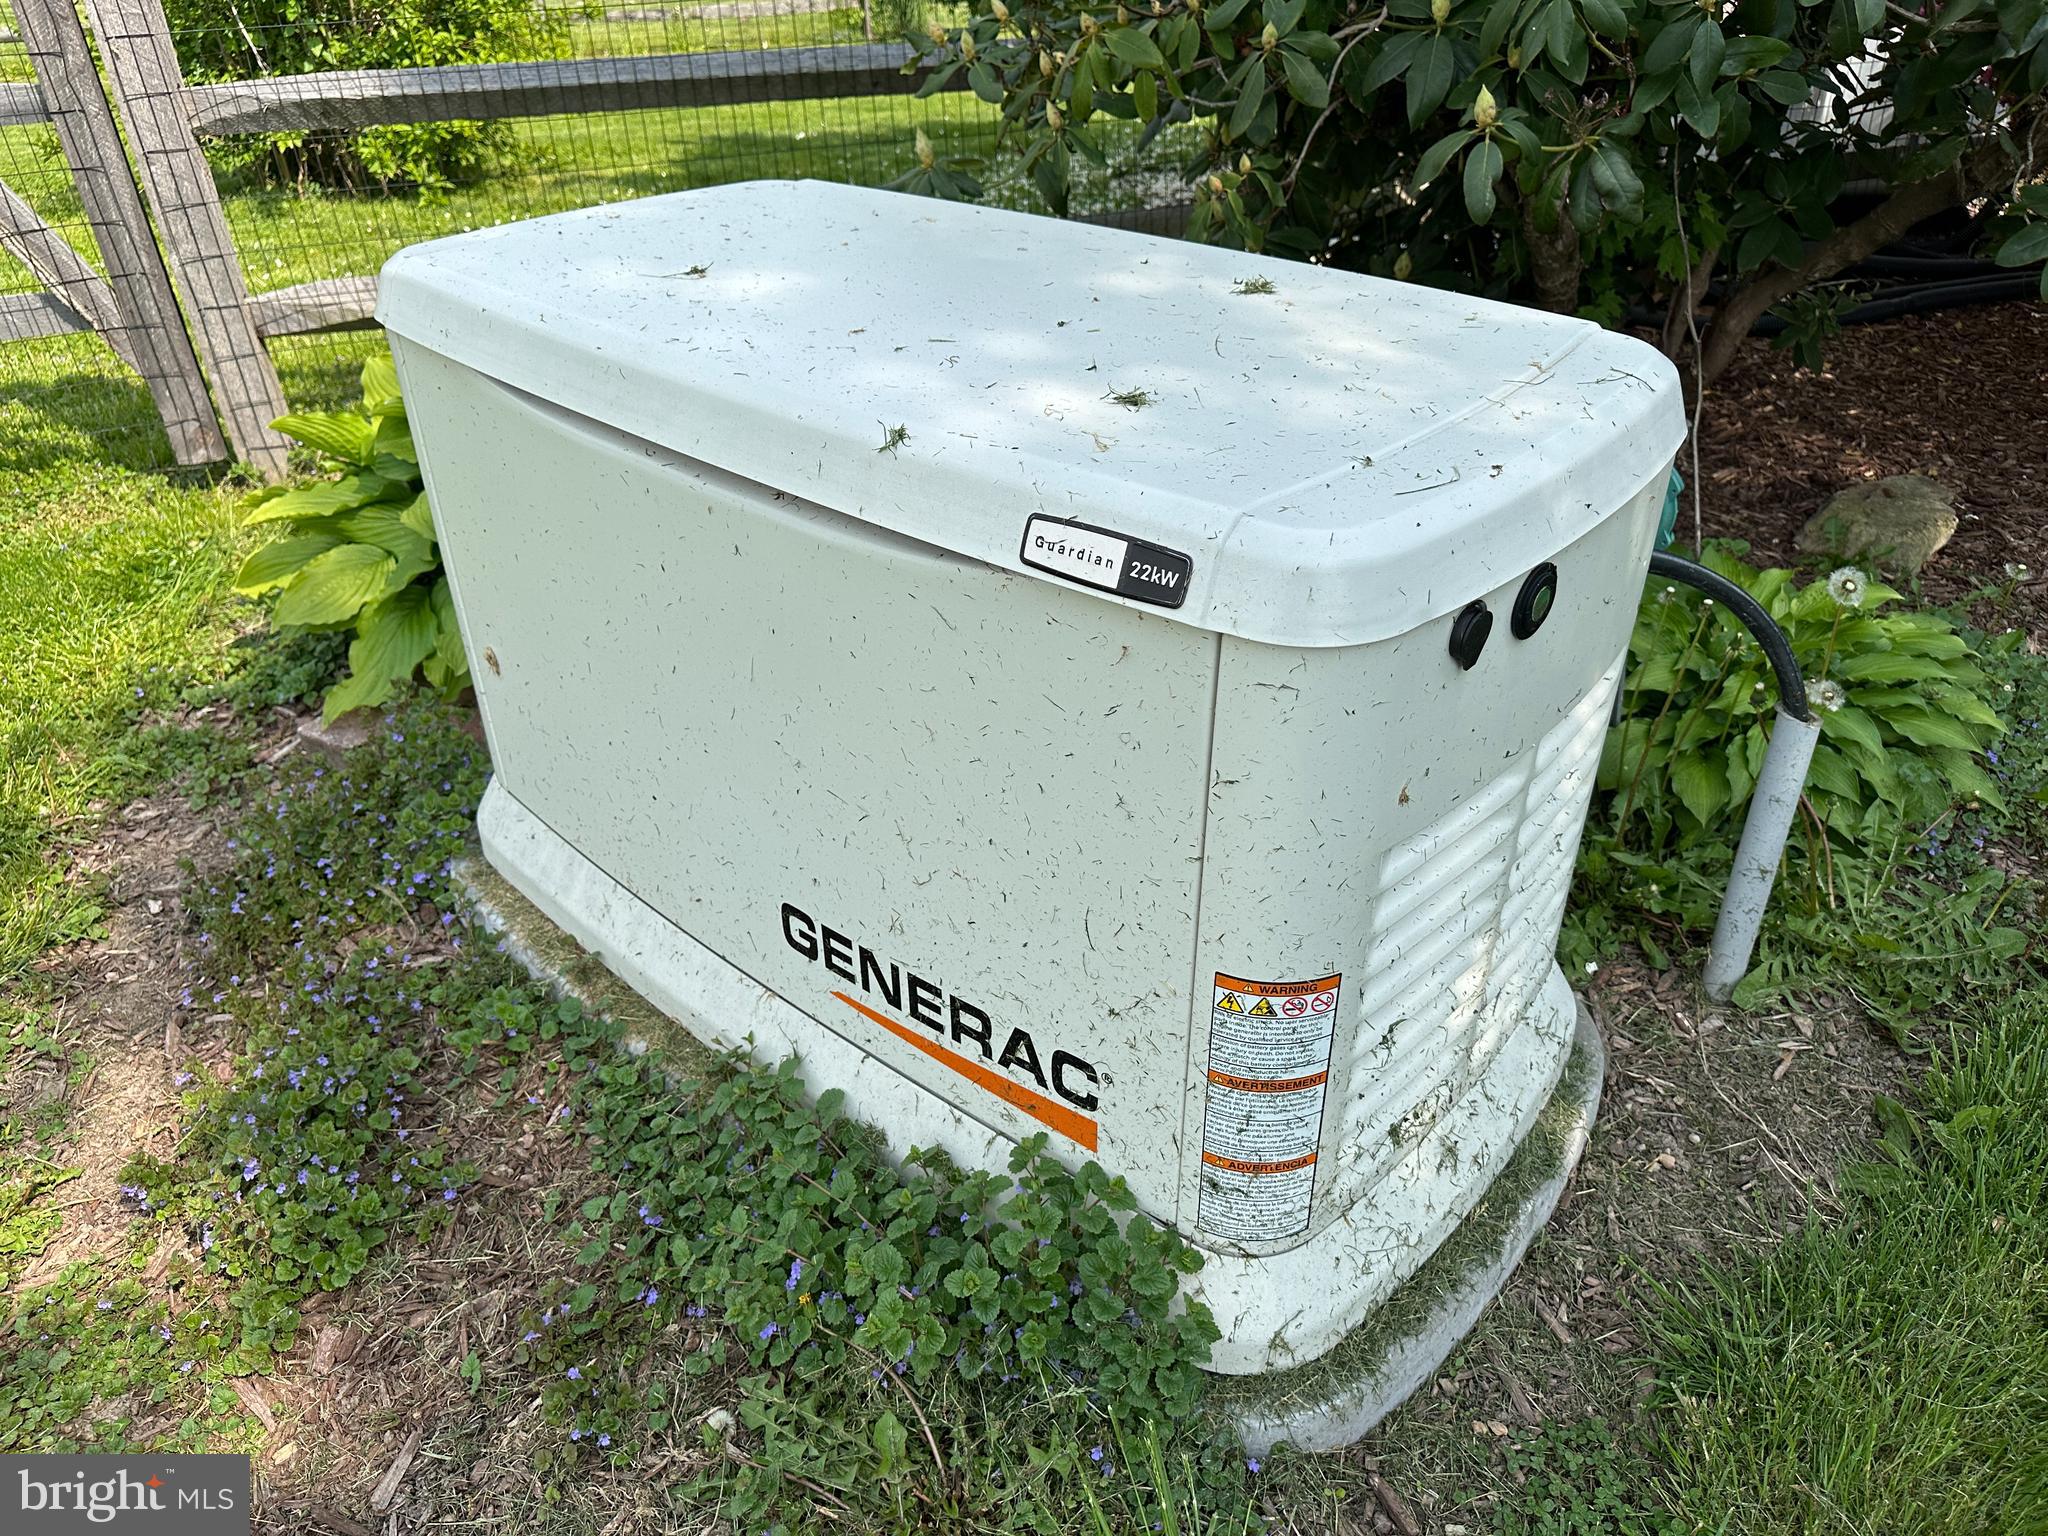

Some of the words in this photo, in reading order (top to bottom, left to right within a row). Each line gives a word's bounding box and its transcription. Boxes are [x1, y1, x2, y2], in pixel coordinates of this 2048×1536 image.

[1035, 536, 1113, 569] Guardian
[1130, 561, 1179, 588] 22kW
[1259, 984, 1317, 995] WARNING
[1227, 1074, 1323, 1090] AVERTISSEMENT
[1228, 1158, 1309, 1172] ADVERTENCIA
